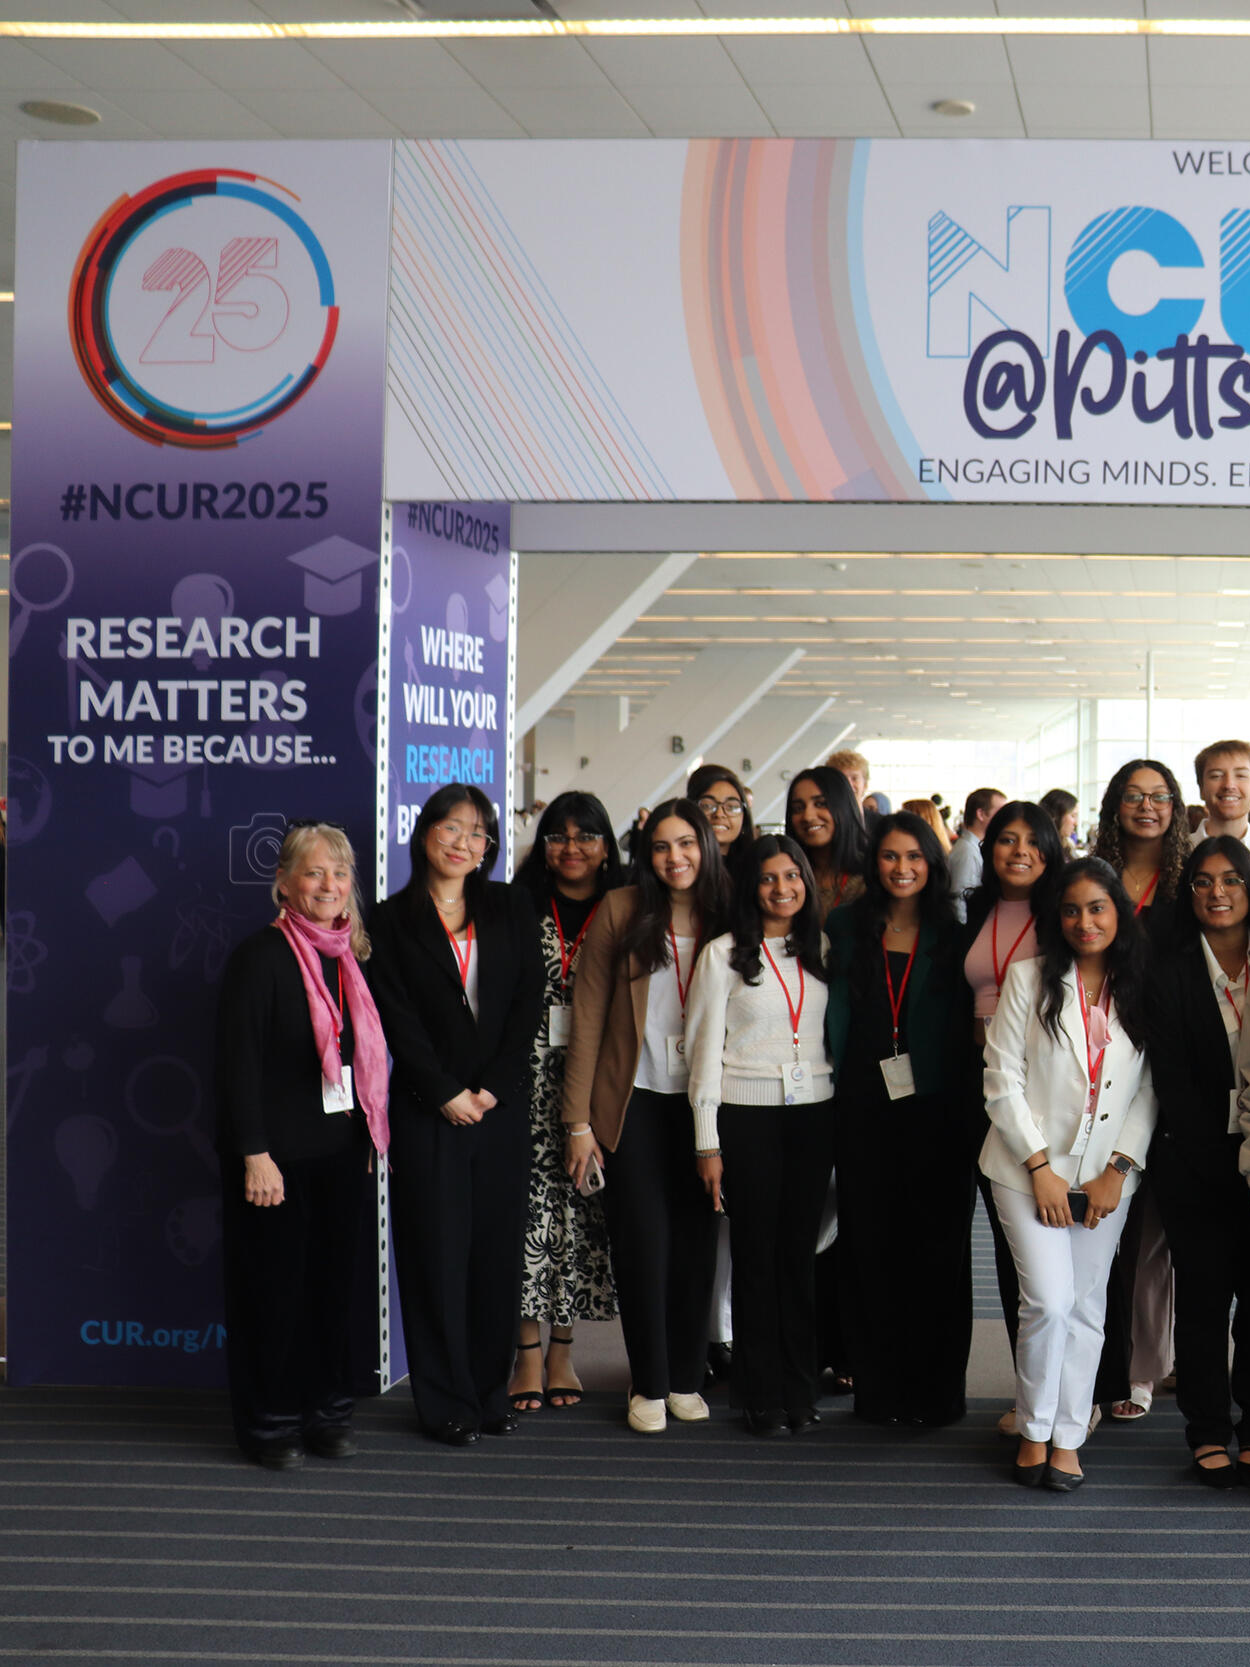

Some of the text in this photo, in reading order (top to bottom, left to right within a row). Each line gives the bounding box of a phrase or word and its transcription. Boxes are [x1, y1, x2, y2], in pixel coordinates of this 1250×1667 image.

[139, 237, 290, 365] 25
[919, 458, 1091, 484] ENGAGING
[1102, 460, 1217, 487] MINDS.
[60, 482, 328, 521] #NCUR2025
[407, 503, 500, 556] #NCUR2025
[66, 617, 320, 658] RESEARCH
[421, 624, 484, 674] WHERE
[79, 680, 308, 722] MATTERS
[403, 683, 497, 730] WILL YOUR
[47, 735, 337, 764] TO ME BECAUSE...
[406, 744, 494, 784] RESEARCH
[671, 735, 685, 754] B
